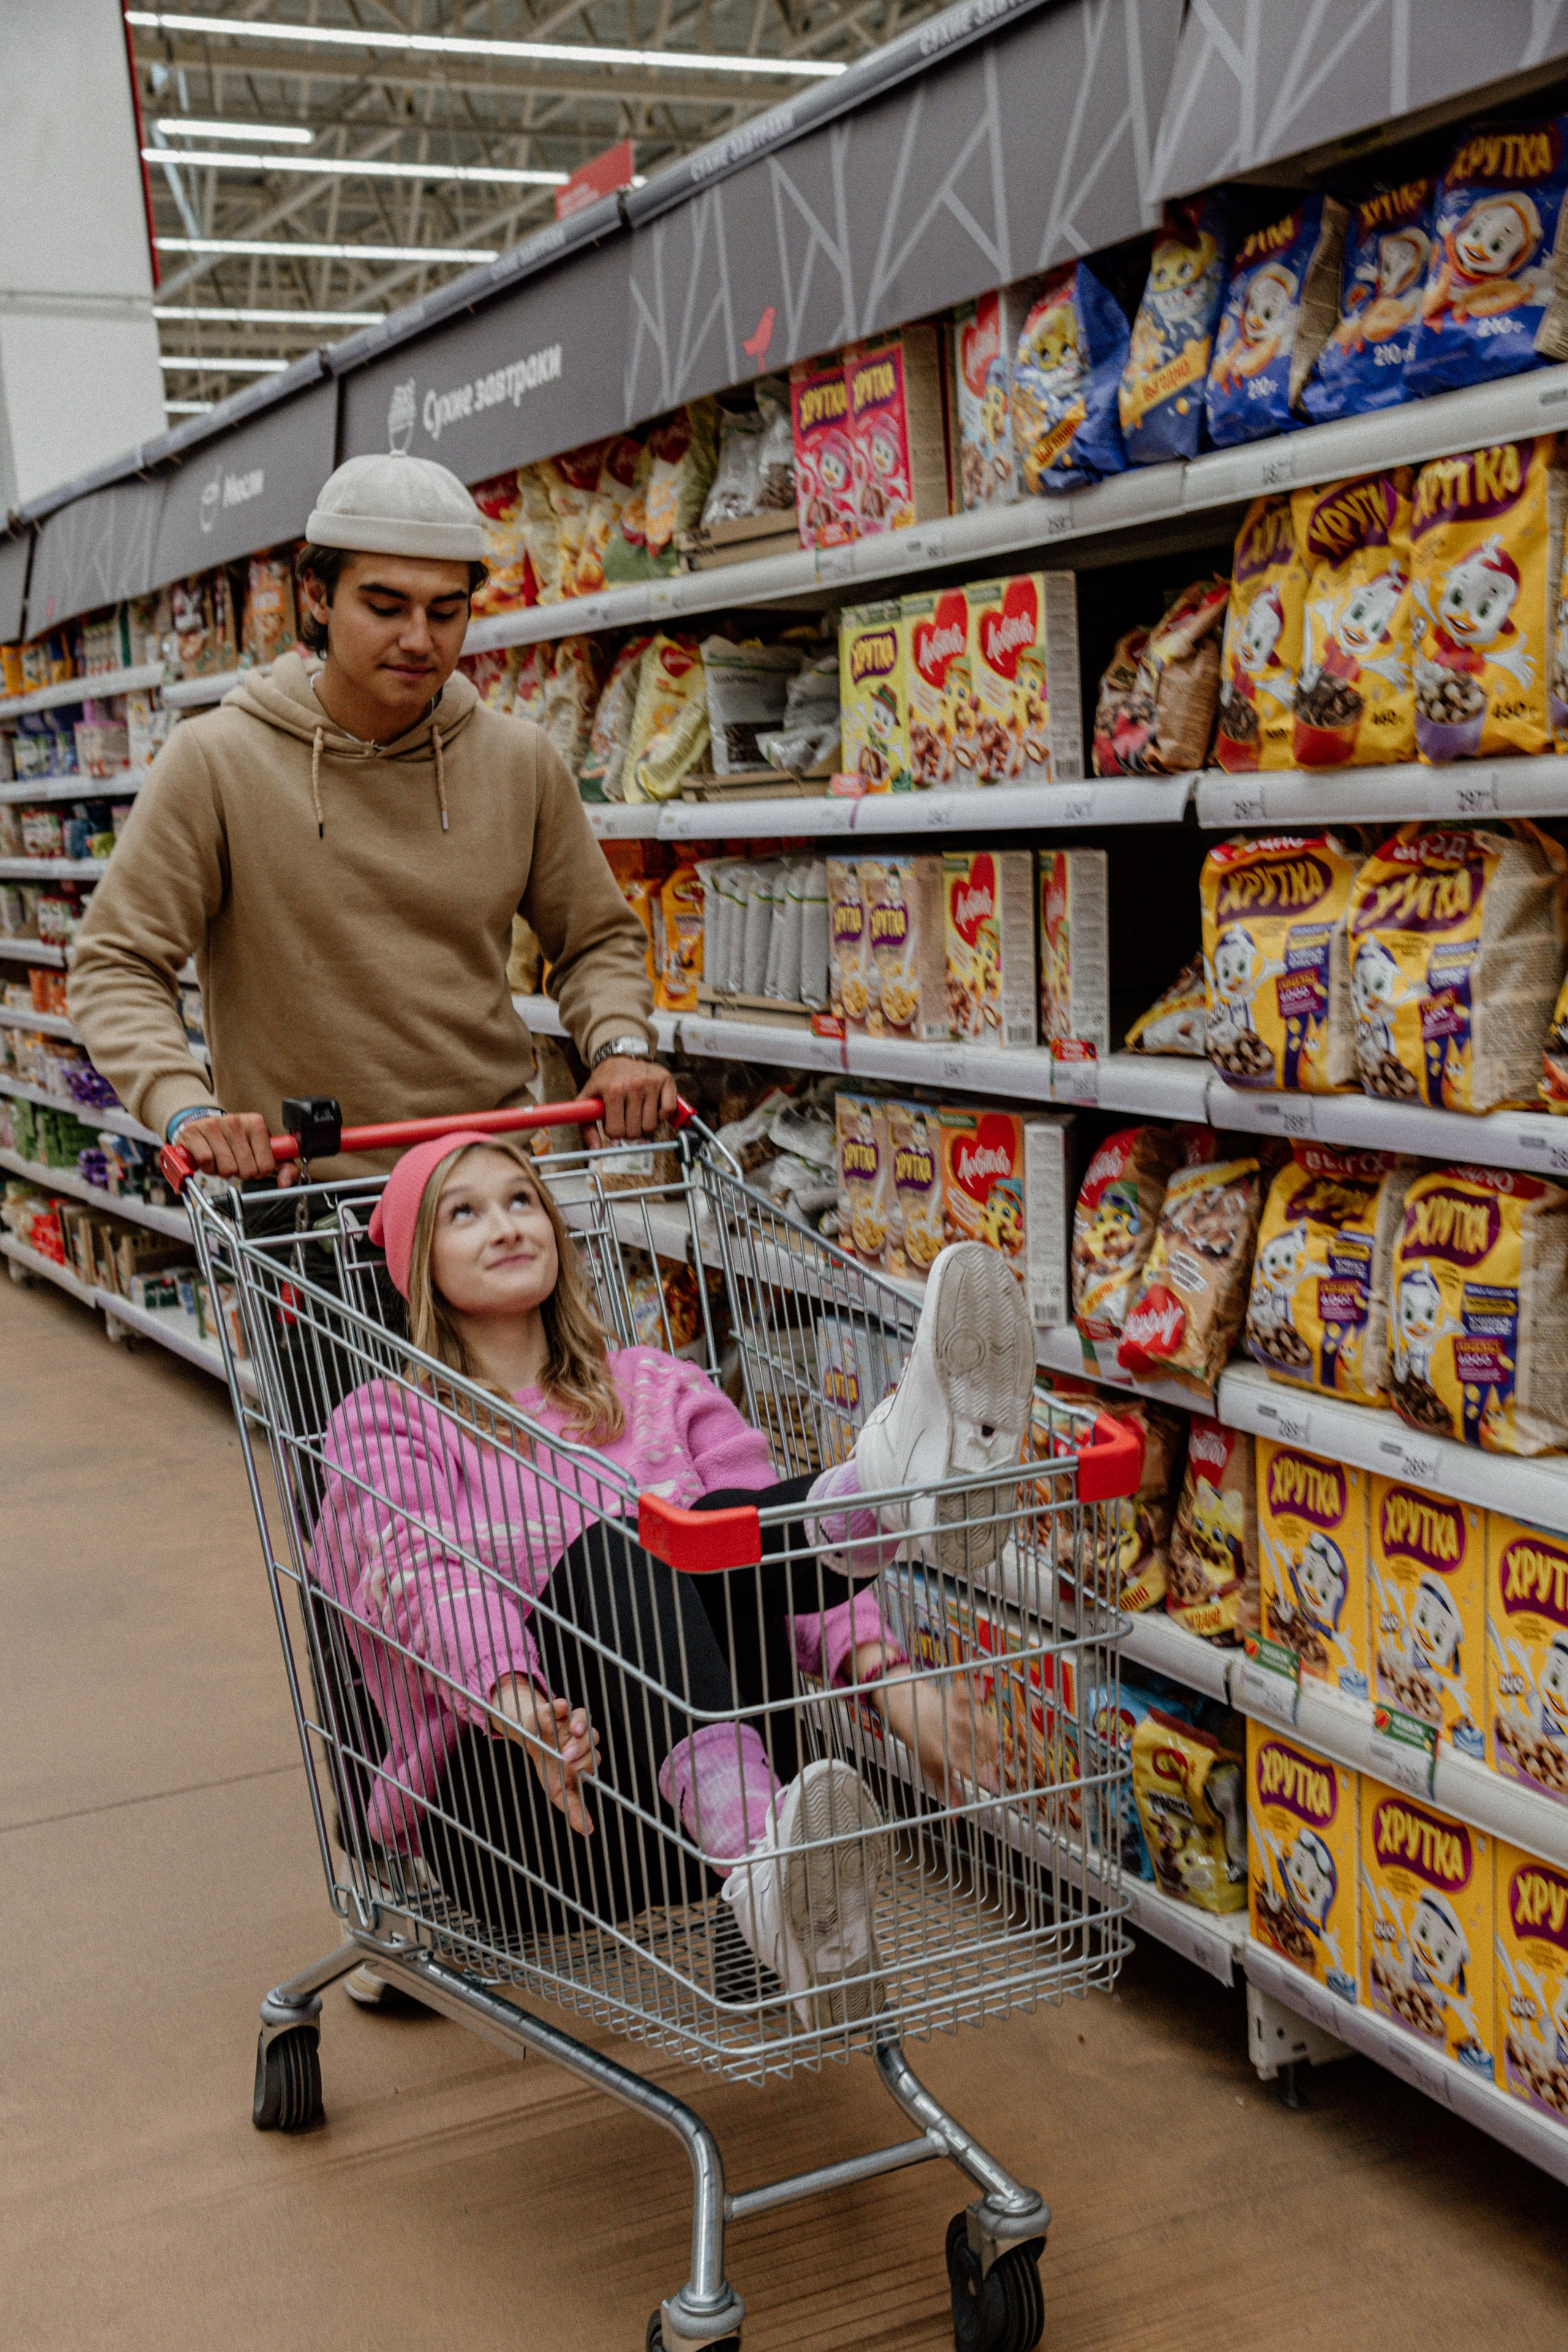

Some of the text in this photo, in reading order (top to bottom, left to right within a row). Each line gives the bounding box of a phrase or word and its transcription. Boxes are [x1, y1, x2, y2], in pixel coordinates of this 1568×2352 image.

[423, 344, 562, 440] Сухие завтраки
[800, 381, 847, 430] ХРУТКА
[852, 361, 895, 415] ХРУТКА
[853, 633, 897, 675] ХРУТКА
[1218, 860, 1325, 916] ХРУТКА
[870, 908, 908, 940] ХРУТКА
[843, 1142, 876, 1170] ХРУТКА
[895, 1152, 933, 1182] ХРУТКА
[1271, 1455, 1341, 1517] ХРУТКА
[1384, 1493, 1459, 1562] ХРУТКА
[1261, 1747, 1332, 1818] ХРУТКА
[1378, 1806, 1467, 1881] ХРУТКА
